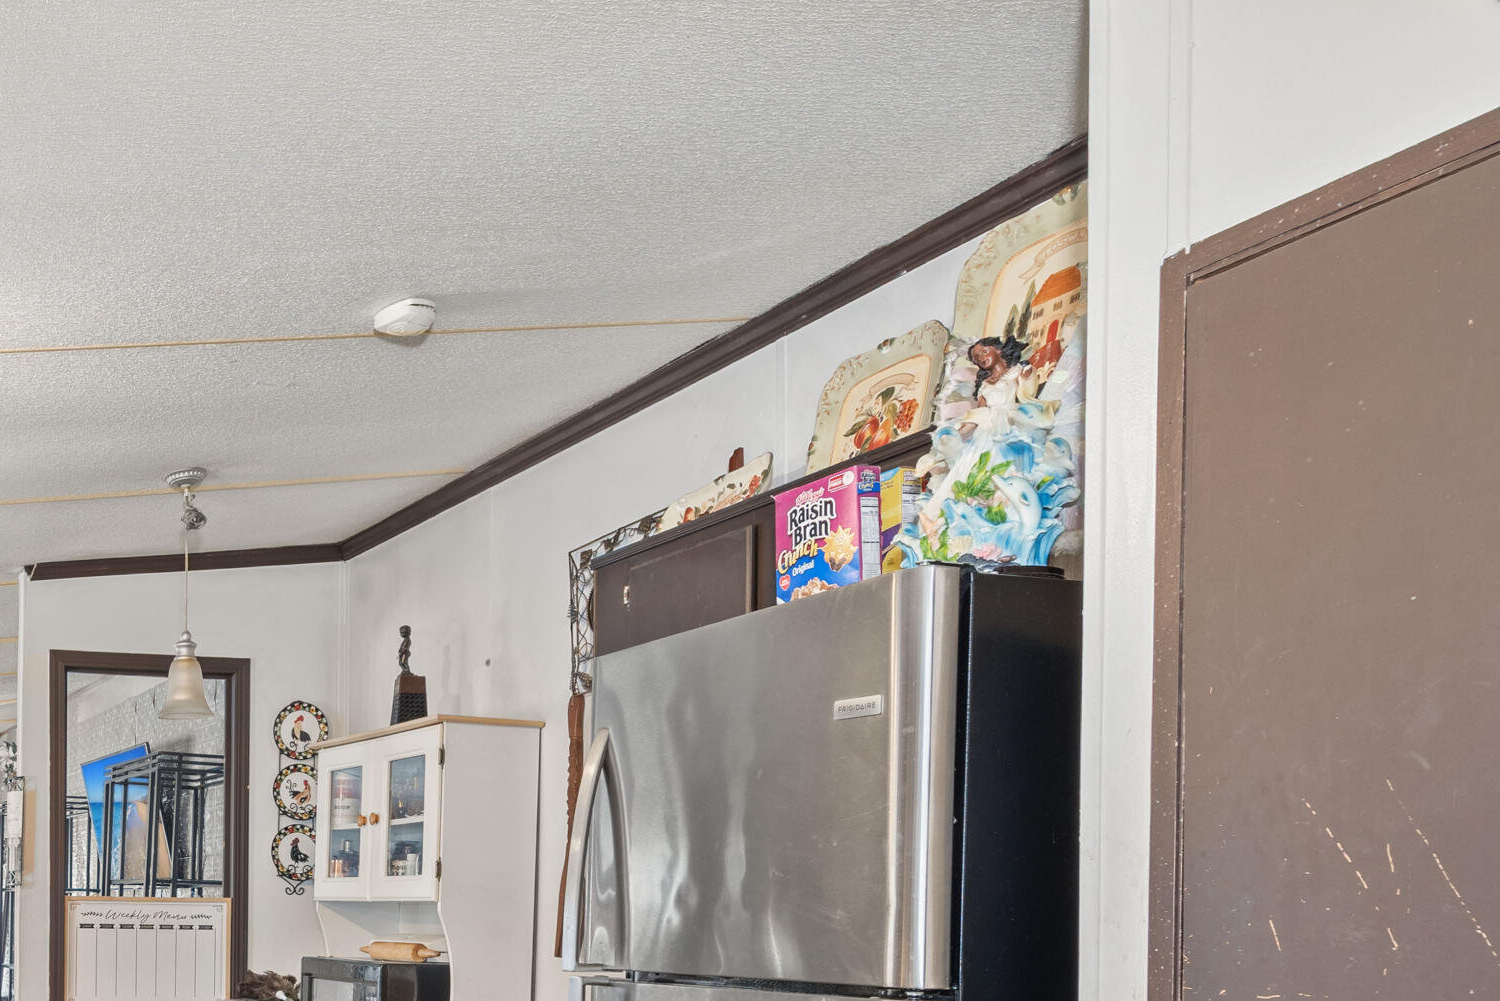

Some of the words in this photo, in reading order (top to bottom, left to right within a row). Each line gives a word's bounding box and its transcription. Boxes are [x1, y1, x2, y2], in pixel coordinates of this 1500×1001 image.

[789, 499, 835, 528] Raisin
[794, 519, 830, 548] Bran
[778, 539, 818, 574] Crunch
[792, 559, 815, 577] Original
[836, 701, 877, 713] FRIGIDAIRE
[105, 909, 150, 923] Weekly
[153, 910, 187, 921] Menu
